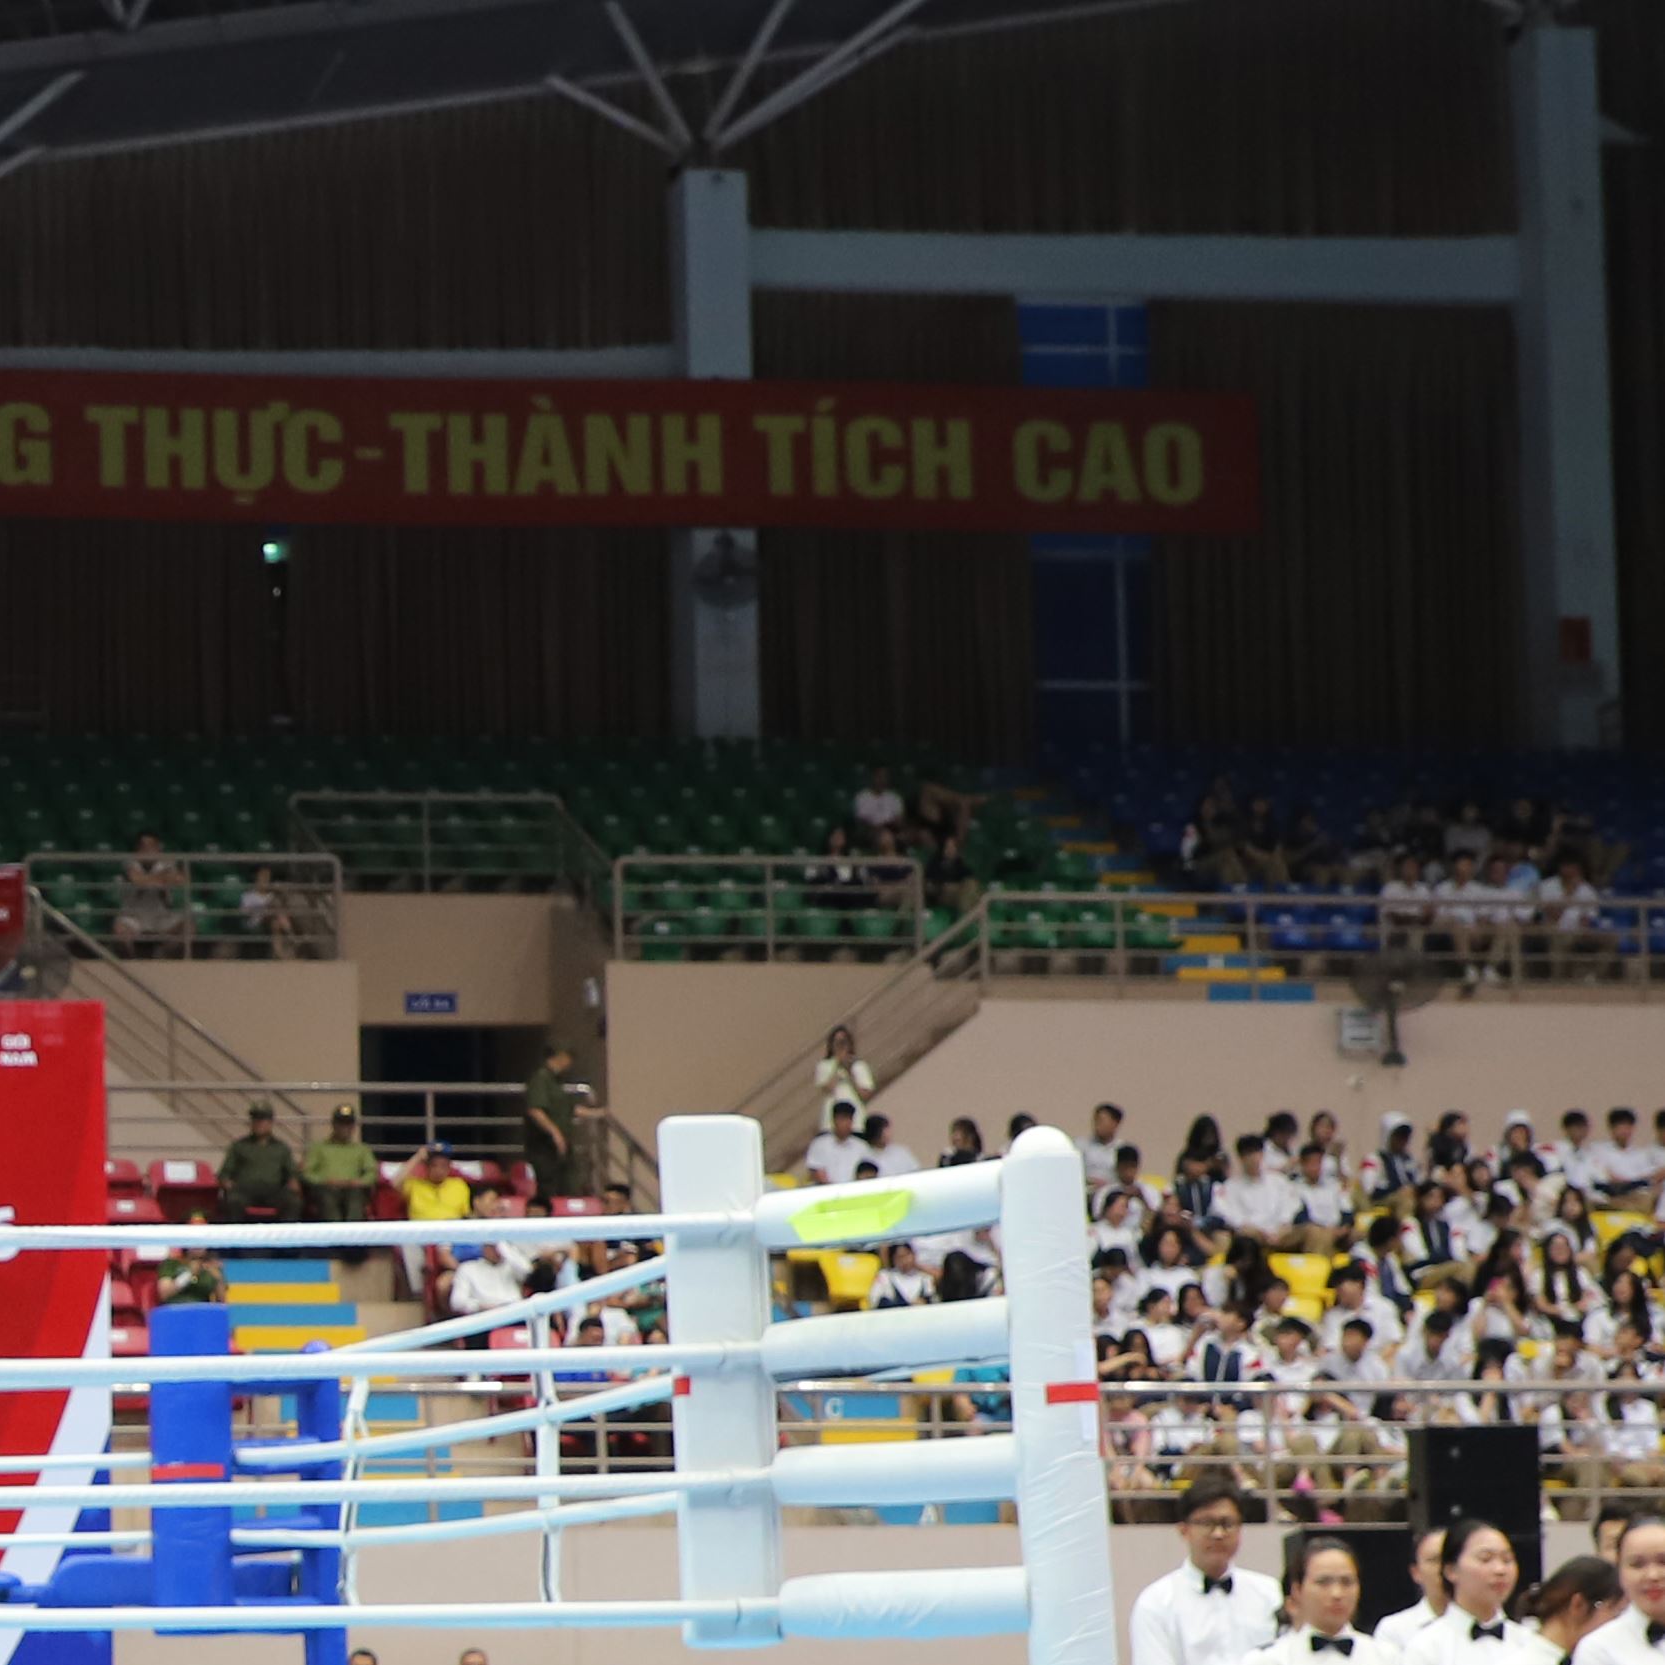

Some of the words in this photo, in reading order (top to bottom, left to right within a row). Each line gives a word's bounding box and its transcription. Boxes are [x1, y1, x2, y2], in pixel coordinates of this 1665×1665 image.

[85, 396, 725, 503] THỰC-THÀNH
[755, 398, 971, 498] TÍCH
[1011, 417, 1204, 504] CAO
